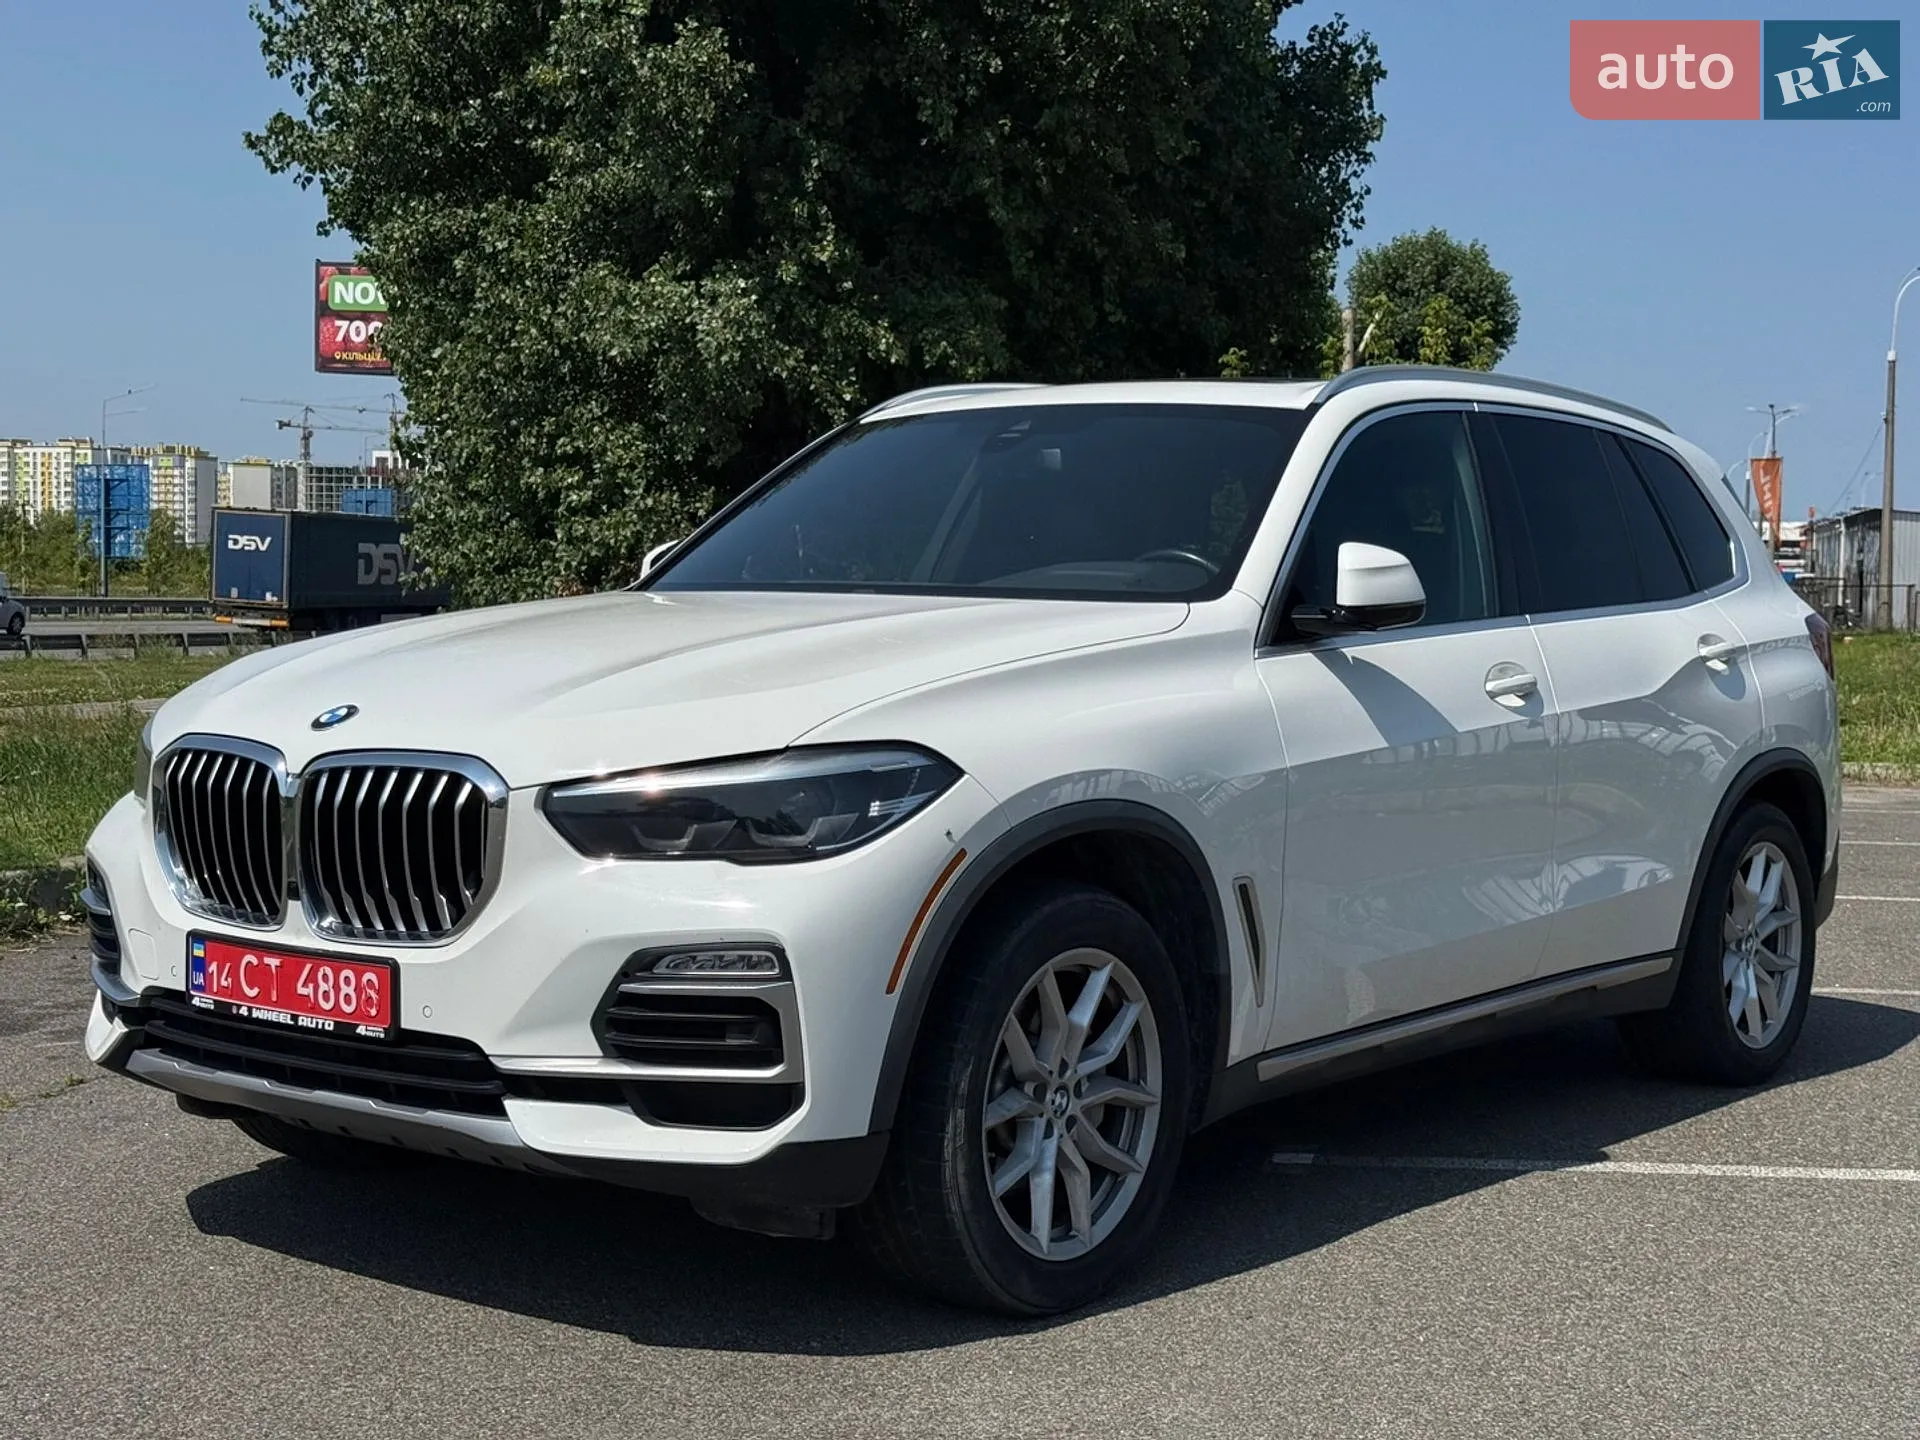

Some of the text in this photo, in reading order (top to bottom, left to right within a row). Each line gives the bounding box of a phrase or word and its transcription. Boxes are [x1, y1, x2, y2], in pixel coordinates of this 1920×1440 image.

[227, 534, 273, 552] DSV
[193, 972, 204, 986] UA
[208, 960, 233, 995] 14
[239, 954, 282, 1002] CT
[239, 1006, 335, 1031] 4 WHEEL AUTO
